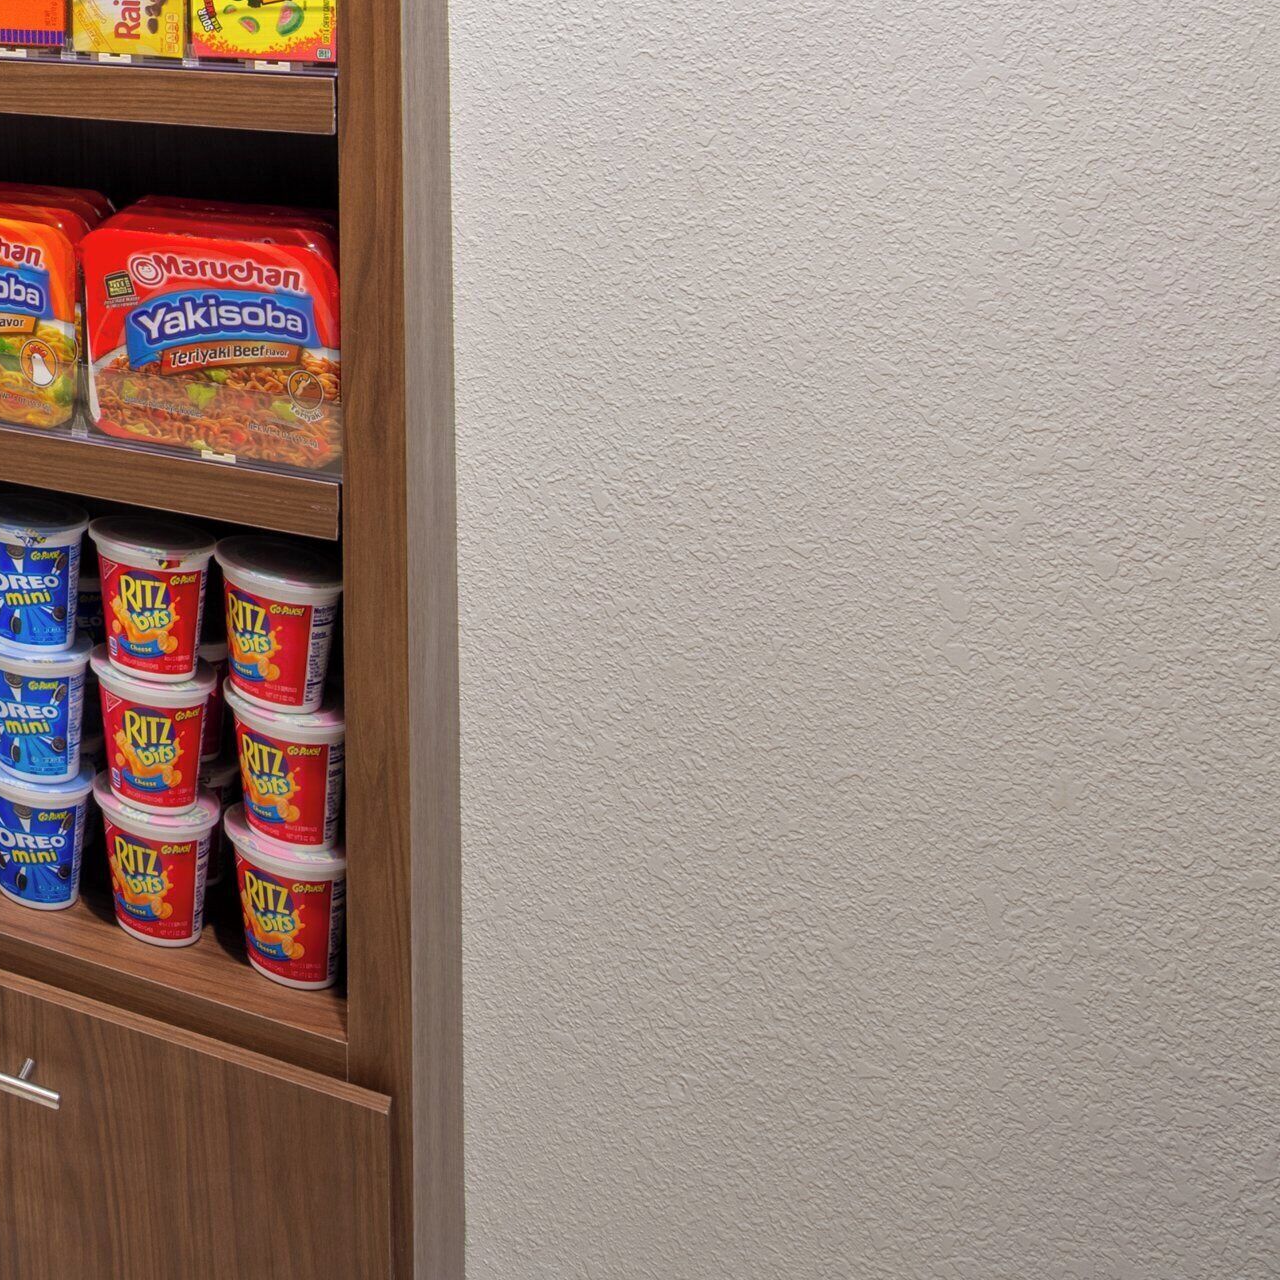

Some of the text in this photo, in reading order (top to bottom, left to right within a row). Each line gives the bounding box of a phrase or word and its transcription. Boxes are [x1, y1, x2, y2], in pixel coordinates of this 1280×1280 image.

[197, 8, 214, 31] SOUR
[153, 254, 301, 291] Maruchan
[138, 298, 303, 339] Yakisoba
[171, 345, 289, 367] Teriyaki Beef Flavor
[5, 588, 52, 607] mini
[118, 574, 167, 611] RITZ
[131, 607, 177, 631] bits
[227, 592, 266, 634] RITZ
[238, 631, 271, 653] bits
[244, 870, 289, 915] RITZ
[257, 911, 295, 934] bits
